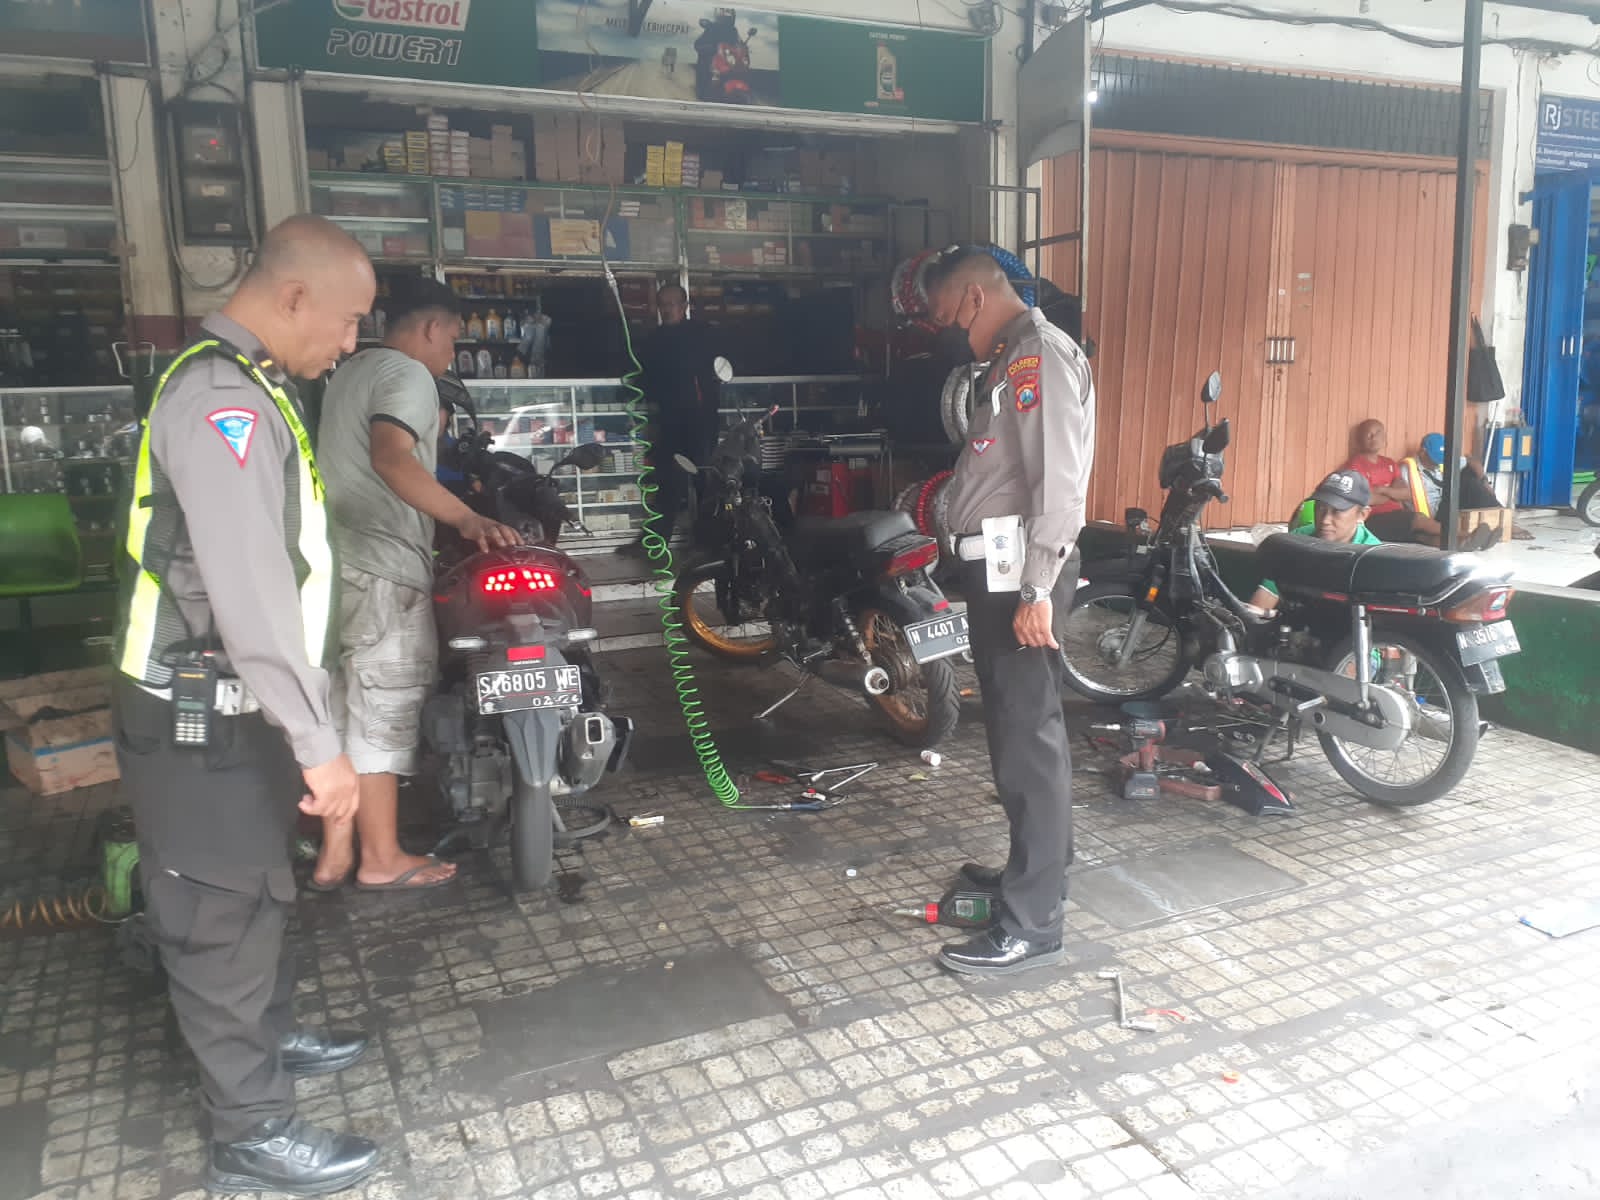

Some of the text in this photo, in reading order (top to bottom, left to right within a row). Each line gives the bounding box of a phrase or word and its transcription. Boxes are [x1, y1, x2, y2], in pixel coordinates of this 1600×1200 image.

[366, 0, 461, 26] Castrol
[911, 630, 921, 644] N
[501, 671, 546, 693] 6805
